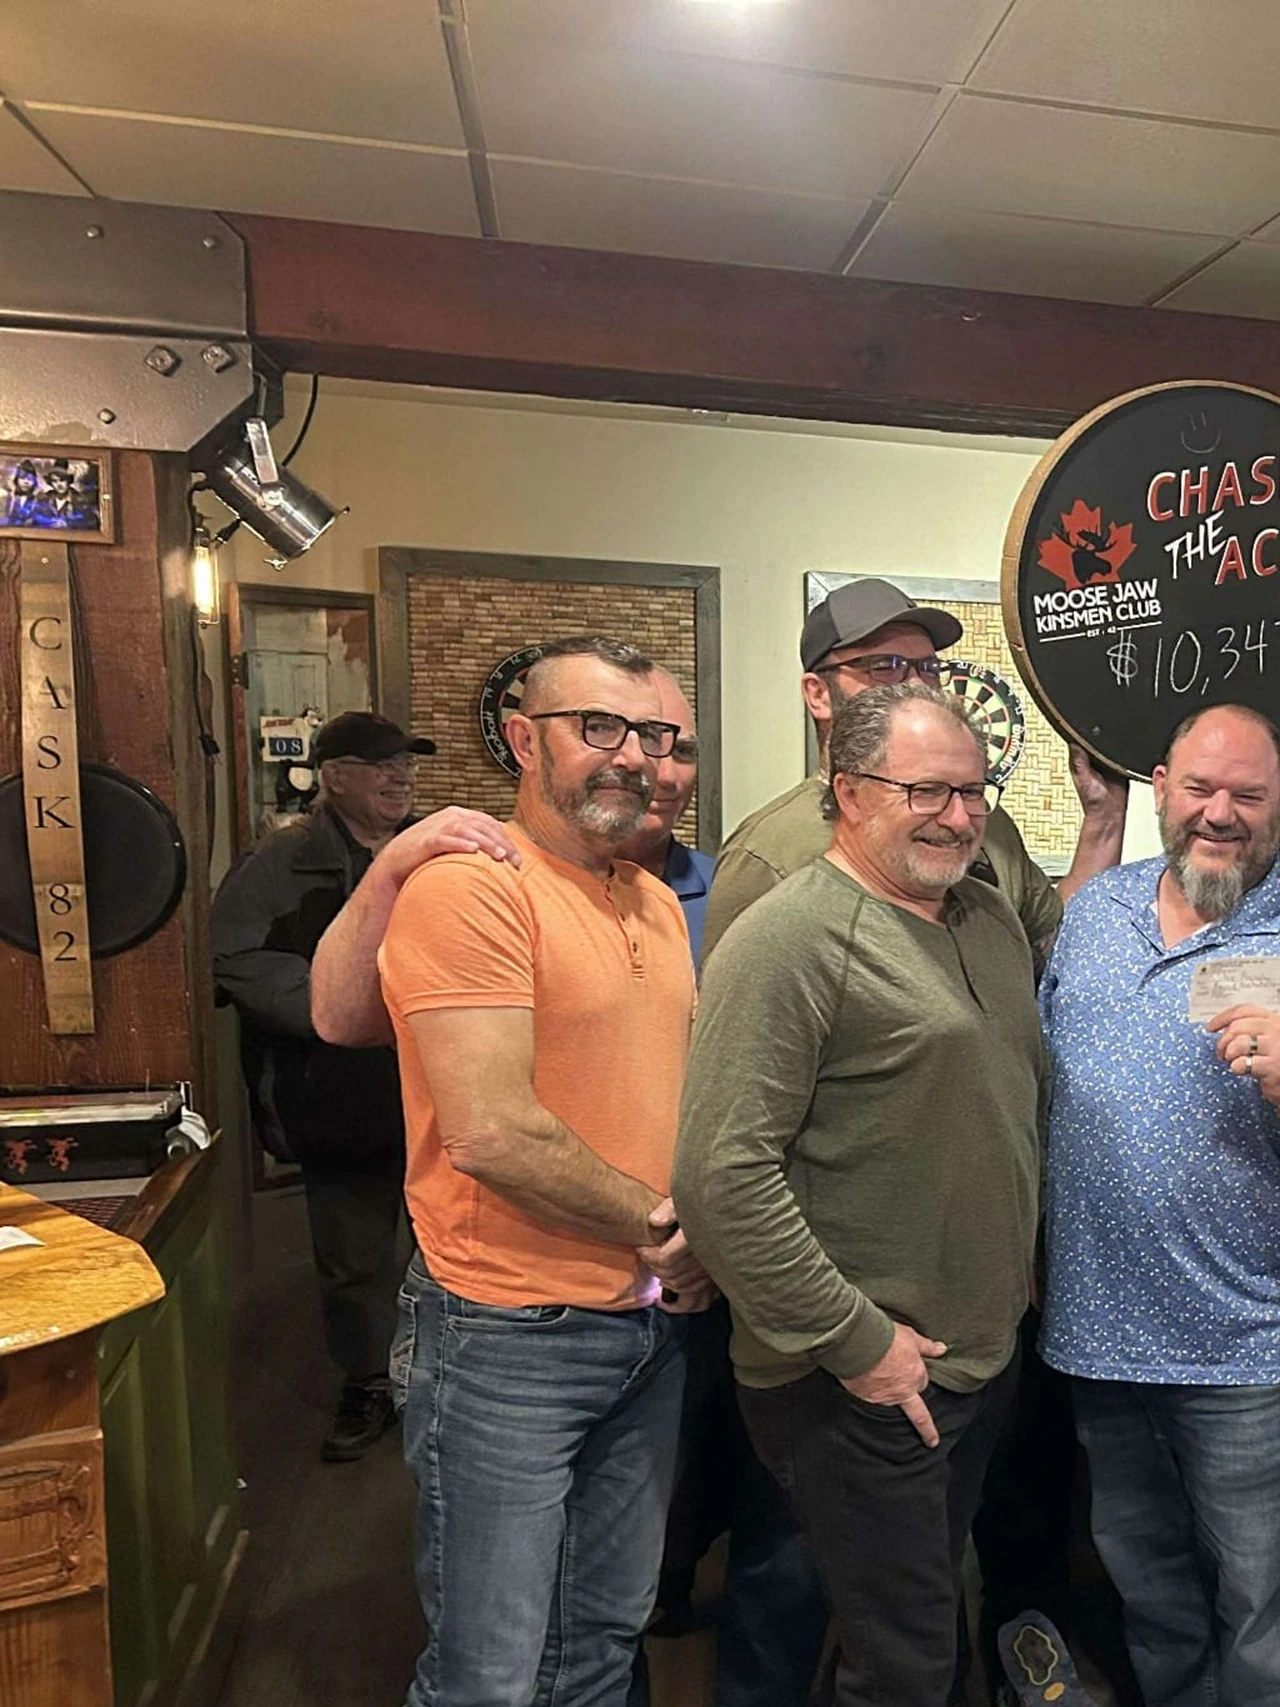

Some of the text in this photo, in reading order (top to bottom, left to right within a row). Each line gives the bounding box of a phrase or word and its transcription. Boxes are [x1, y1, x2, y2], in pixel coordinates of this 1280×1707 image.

[1164, 509, 1227, 580] THE
[1033, 578, 1158, 615] MOOSE JAW
[1036, 599, 1161, 633] KINSMEN CLUB
